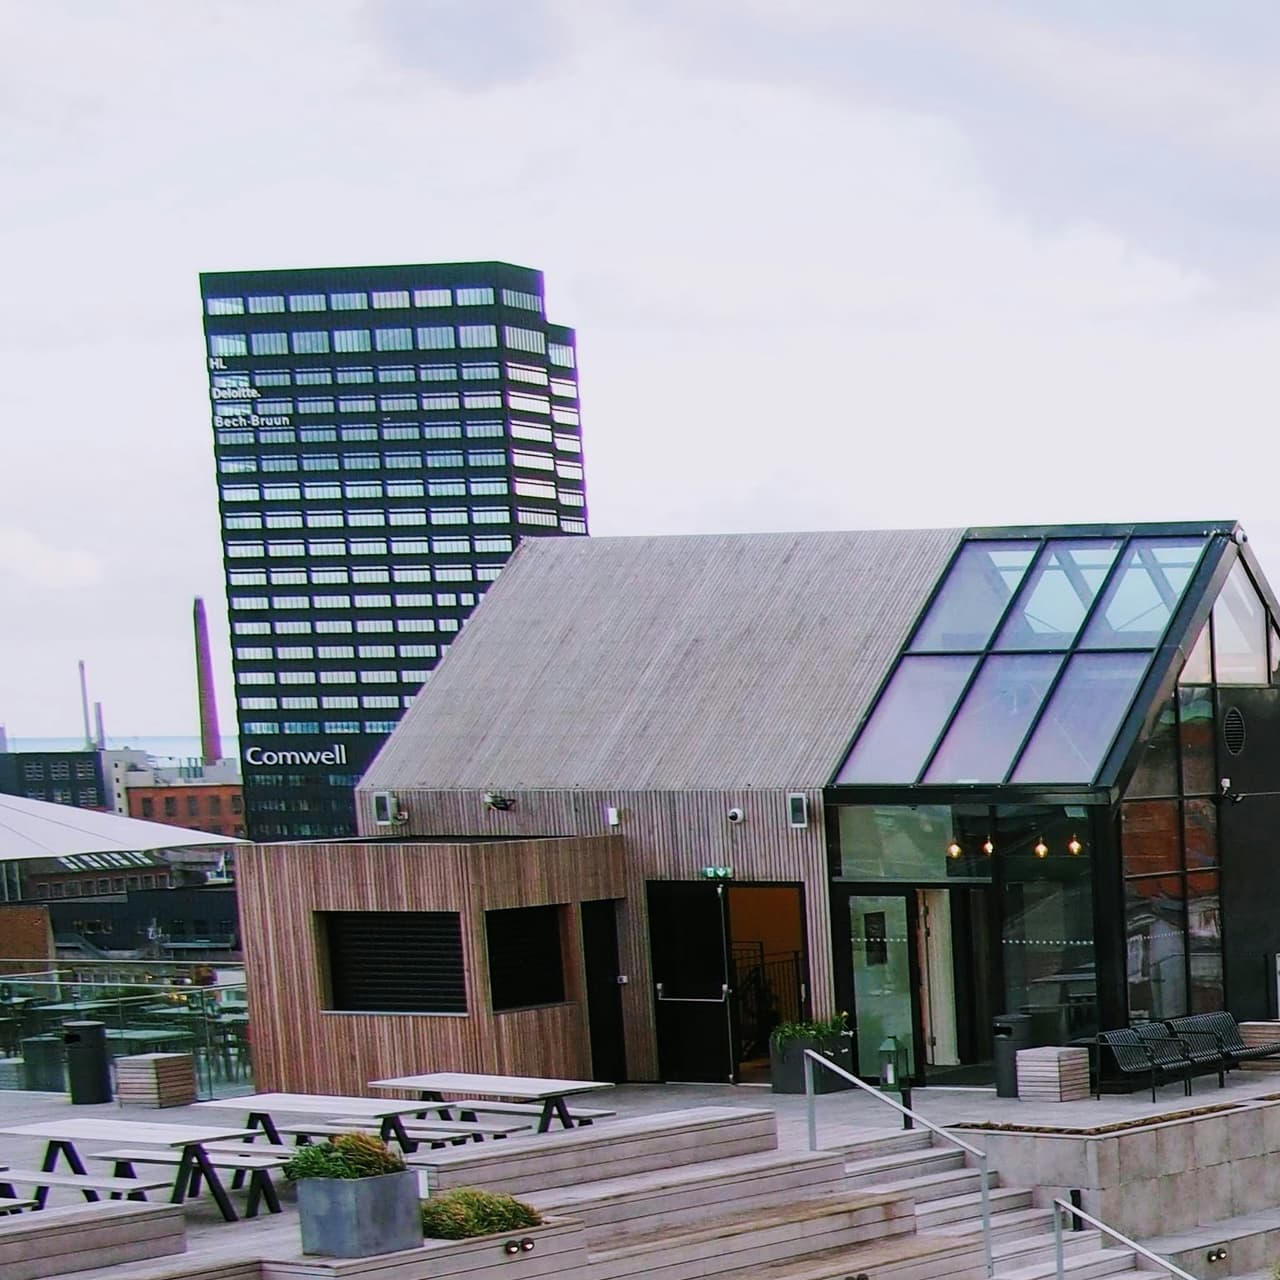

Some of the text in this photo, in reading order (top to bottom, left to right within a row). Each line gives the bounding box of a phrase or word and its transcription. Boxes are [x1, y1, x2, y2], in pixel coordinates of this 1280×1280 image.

[209, 358, 227, 369] HL
[212, 387, 261, 399] Deloitte.
[246, 744, 346, 765] Comwell
